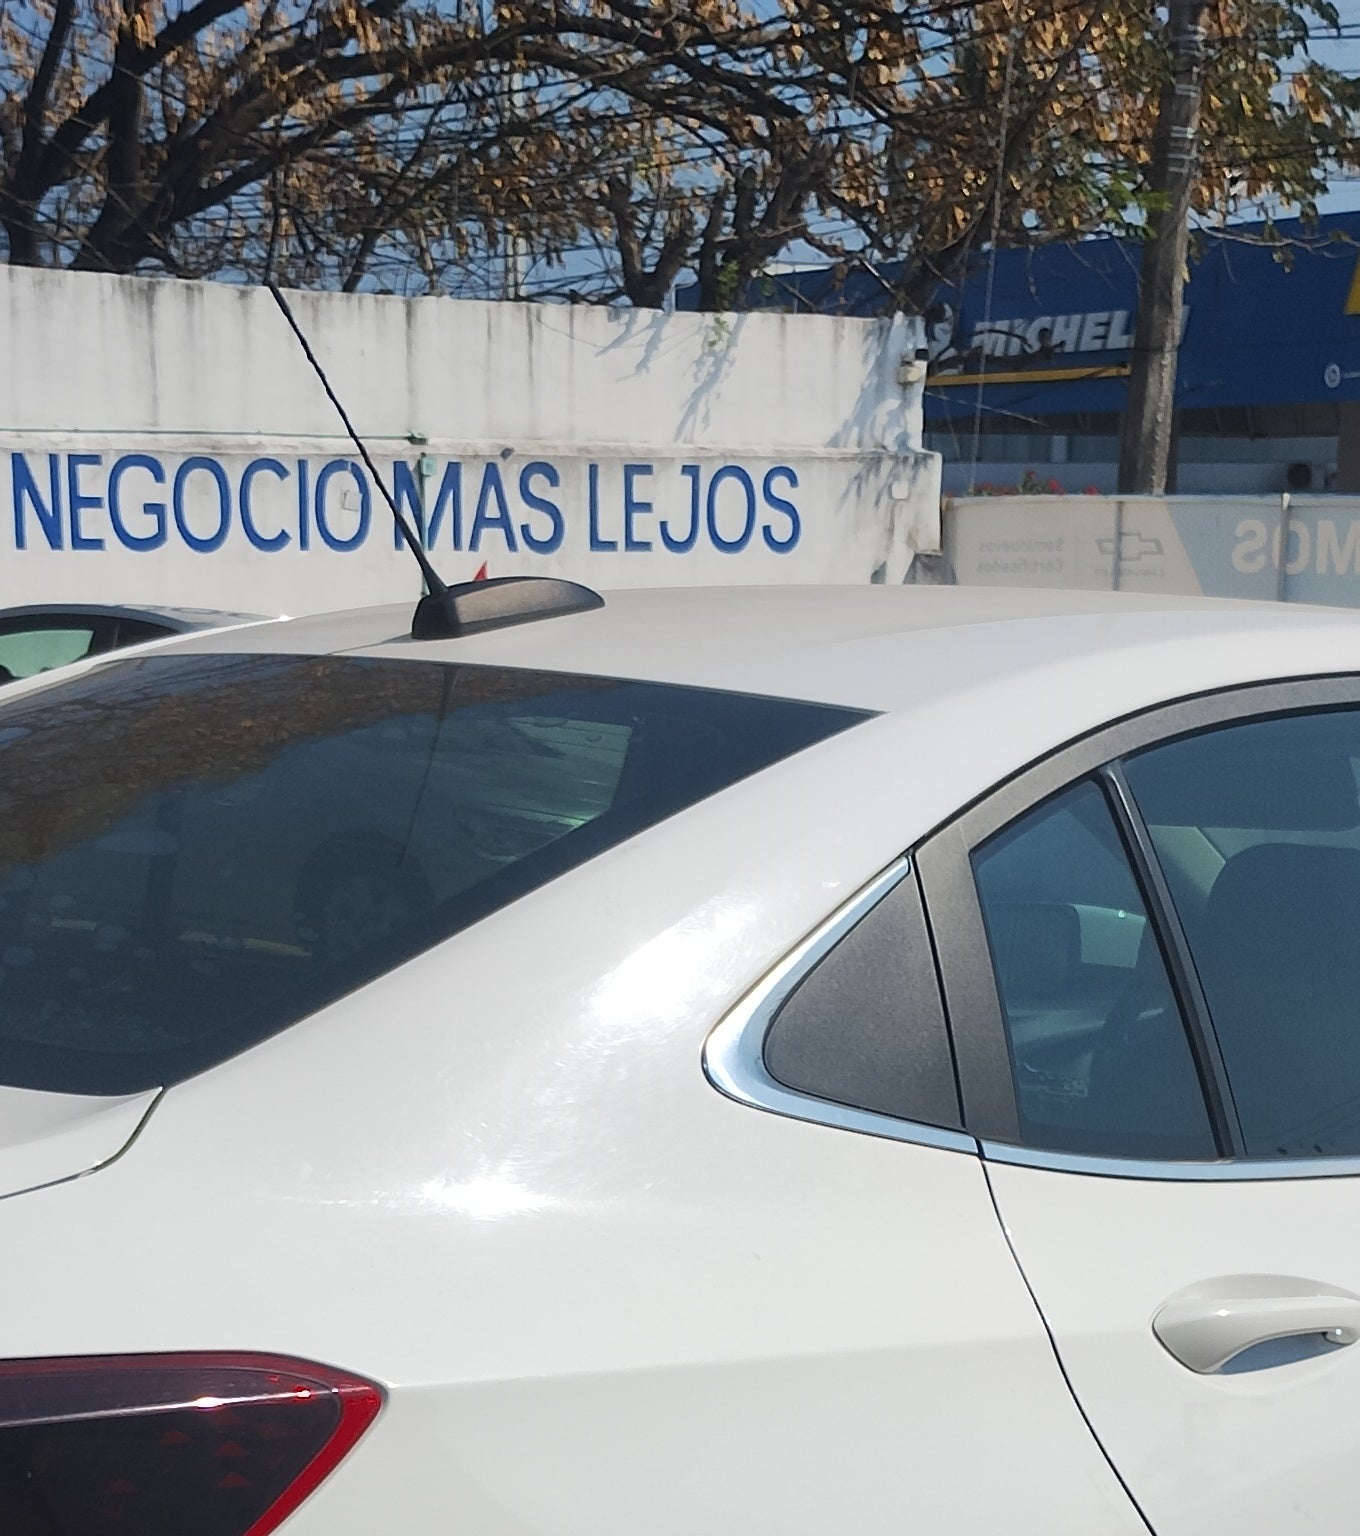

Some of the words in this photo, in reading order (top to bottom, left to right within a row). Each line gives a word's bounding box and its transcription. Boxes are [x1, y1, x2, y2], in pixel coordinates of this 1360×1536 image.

[970, 305, 1190, 358] MICHEL
[10, 452, 373, 554] NEGOCIO
[588, 463, 803, 555] LEJOS
